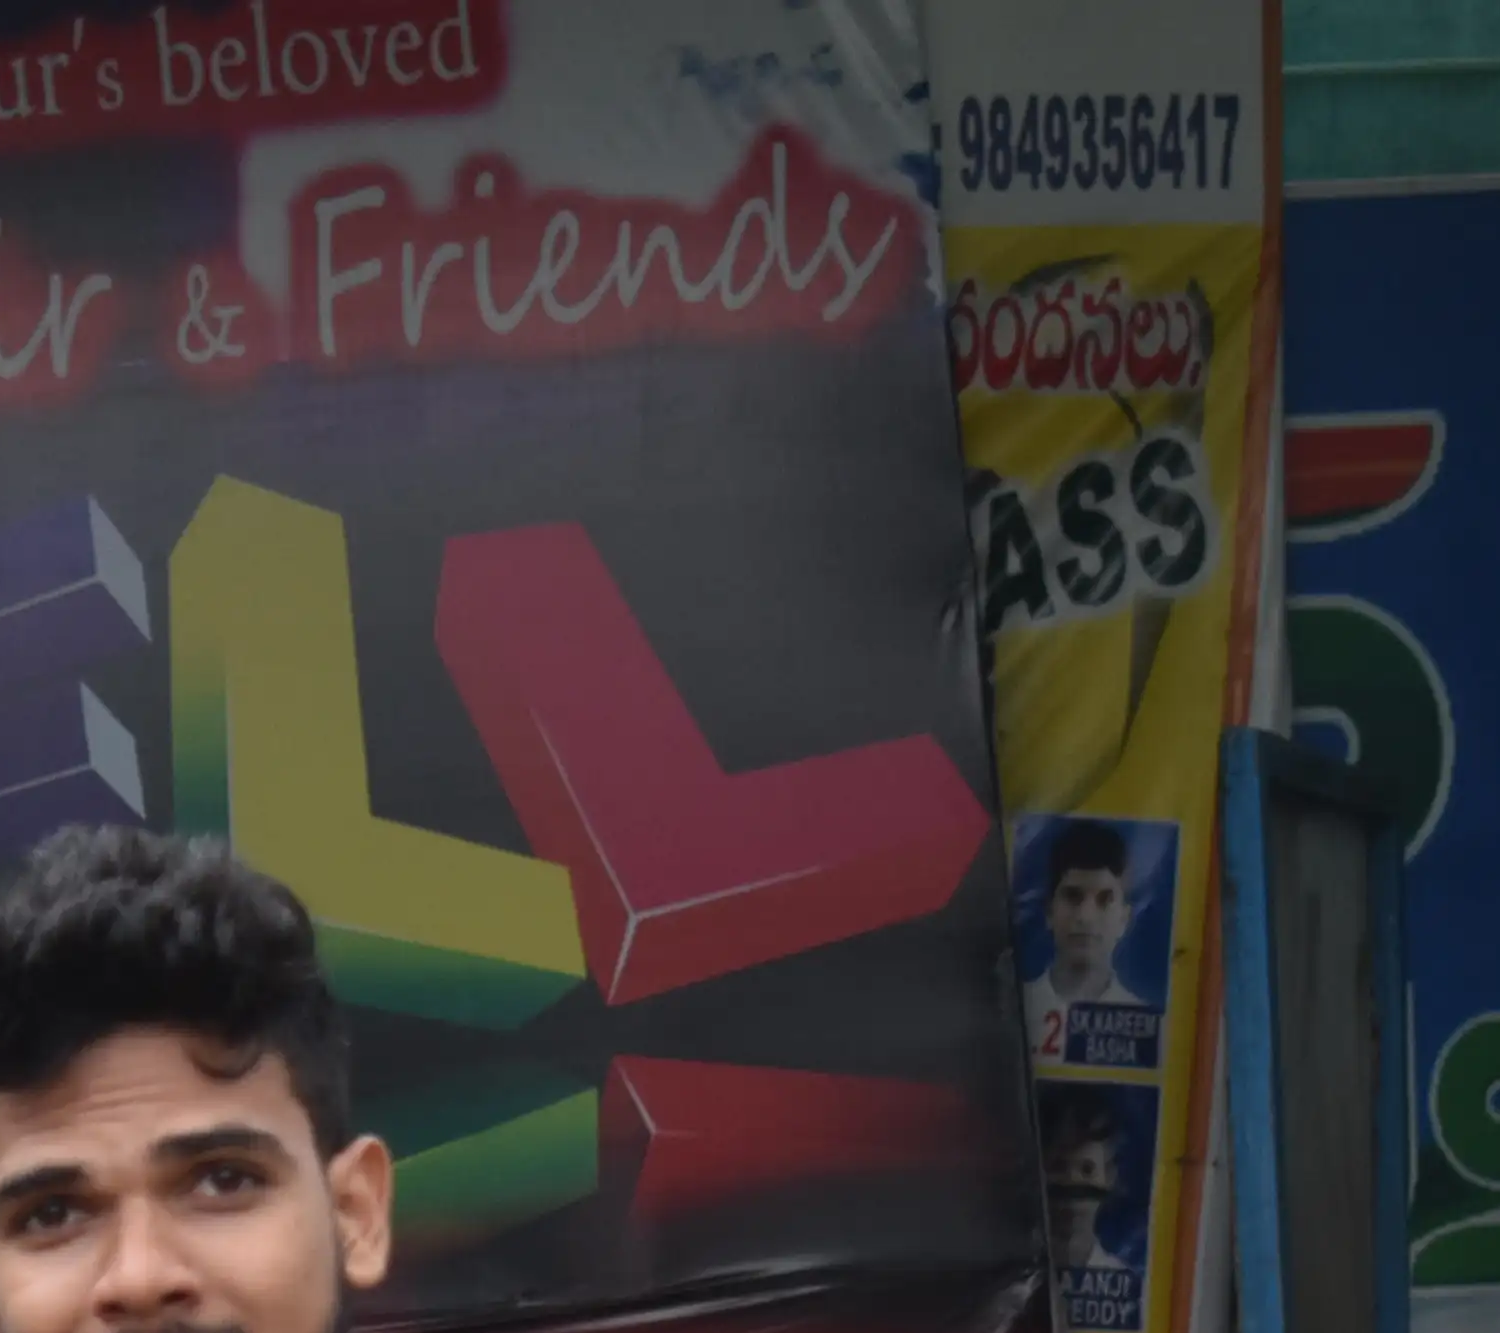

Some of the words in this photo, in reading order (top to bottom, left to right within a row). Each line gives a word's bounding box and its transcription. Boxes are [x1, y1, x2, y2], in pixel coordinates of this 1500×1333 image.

[152, 0, 479, 105] beloved
[959, 94, 1239, 191] 9849356417
[177, 264, 245, 363] &
[315, 142, 898, 358] Friends
[983, 437, 1206, 632] ASS
[1070, 1299, 1136, 1327] EDDY
